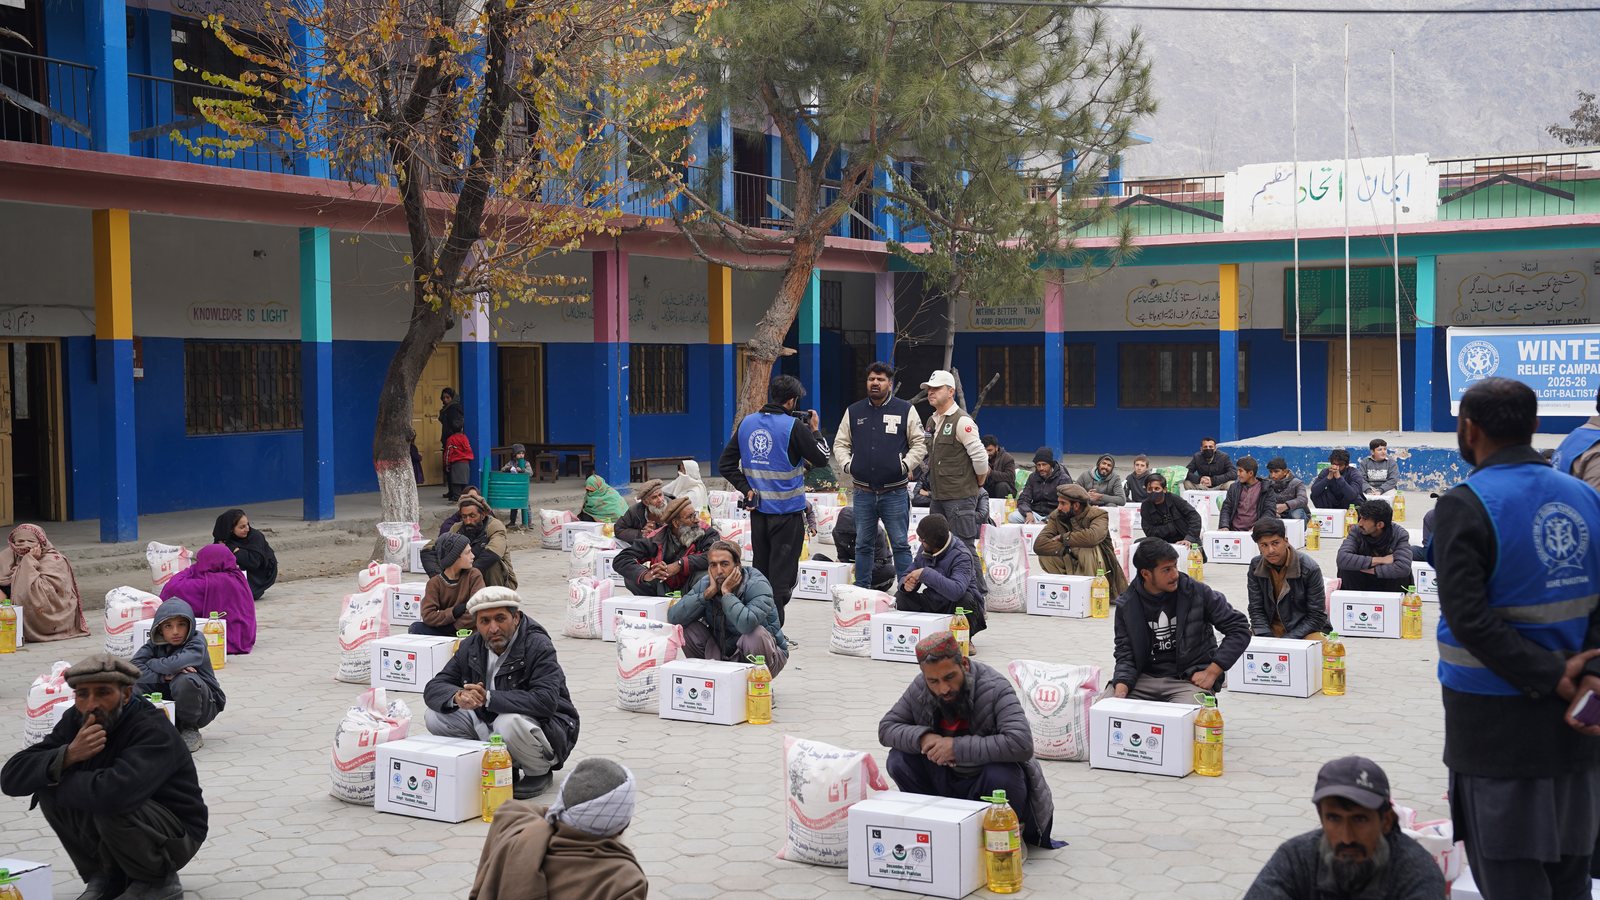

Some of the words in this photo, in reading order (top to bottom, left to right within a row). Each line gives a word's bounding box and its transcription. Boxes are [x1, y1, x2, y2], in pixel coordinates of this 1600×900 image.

[1297, 166, 1343, 204] اتحاد
[1357, 168, 1410, 203] ایمان
[193, 307, 242, 321] KNOWLEDGE
[247, 309, 256, 322] IS
[261, 309, 289, 322] LIGHT
[975, 307, 996, 316] NOTHING
[996, 307, 1018, 316] BETTER
[1024, 306, 1041, 315] THAN
[975, 318, 980, 326] A
[980, 317, 994, 326] GOOD
[994, 317, 1026, 327] EDUCATION
[1517, 339, 1600, 362] WINTE
[1517, 364, 1556, 376] RELIEF
[1547, 376, 1587, 387] 2025-26
[1535, 389, 1599, 398] ILGIT-BALTISTA
[883, 414, 902, 434] T
[1037, 688, 1057, 703] 111
[828, 777, 852, 803] آٹا
